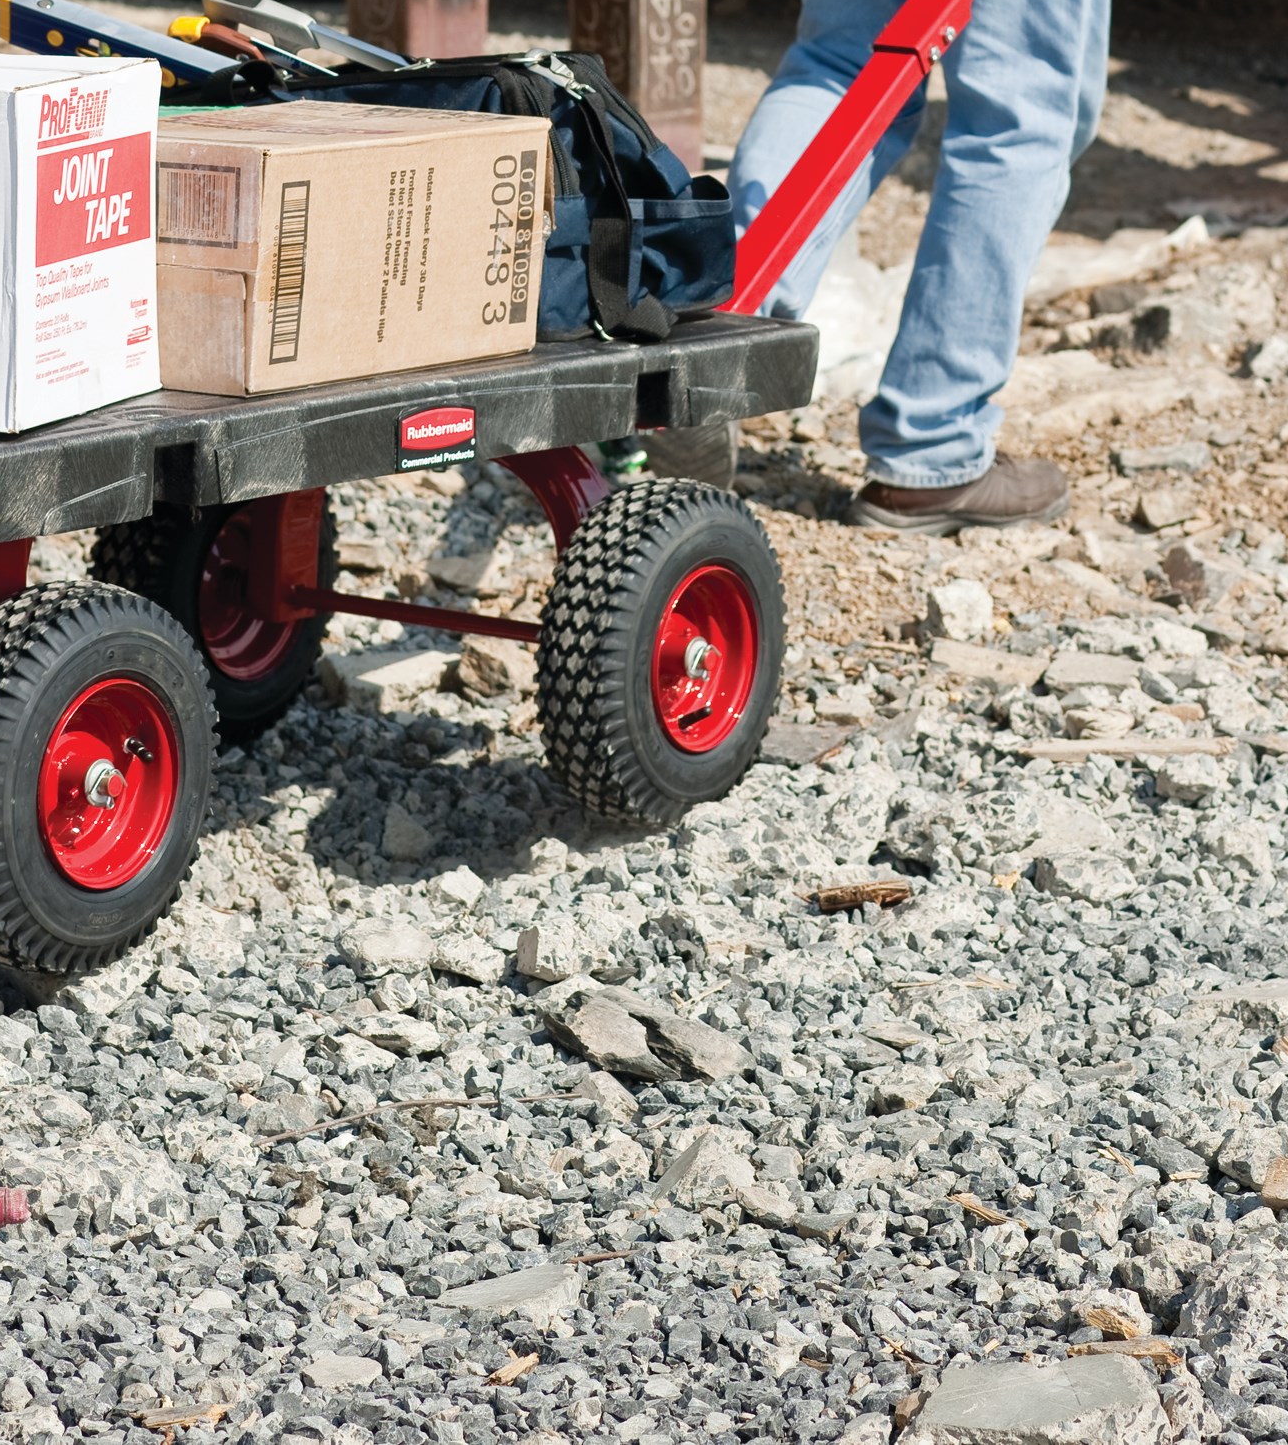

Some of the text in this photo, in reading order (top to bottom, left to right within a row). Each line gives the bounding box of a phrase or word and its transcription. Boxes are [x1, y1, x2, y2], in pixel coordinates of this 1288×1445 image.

[53, 148, 114, 205] JOINT
[389, 171, 397, 186] Do
[399, 170, 407, 184] Do
[388, 188, 396, 207] Not
[85, 191, 133, 244] TAPE
[386, 209, 395, 240] Stack
[396, 208, 404, 238] Store
[400, 169, 416, 286] Protect From Freezing
[417, 167, 435, 312] Rotate Stock Every 30 Days
[481, 155, 517, 326] 00448 3
[511, 168, 535, 303] 0 00 81099
[384, 242, 393, 269] Over
[392, 239, 401, 280] Outside
[35, 274, 47, 290] Top
[70, 264, 83, 280] Tape
[35, 292, 61, 310] Gypsum
[379, 278, 389, 316] Pallets
[377, 318, 385, 343] High
[407, 418, 473, 440] Rubbermaid
[401, 449, 475, 468] Commercial Products
